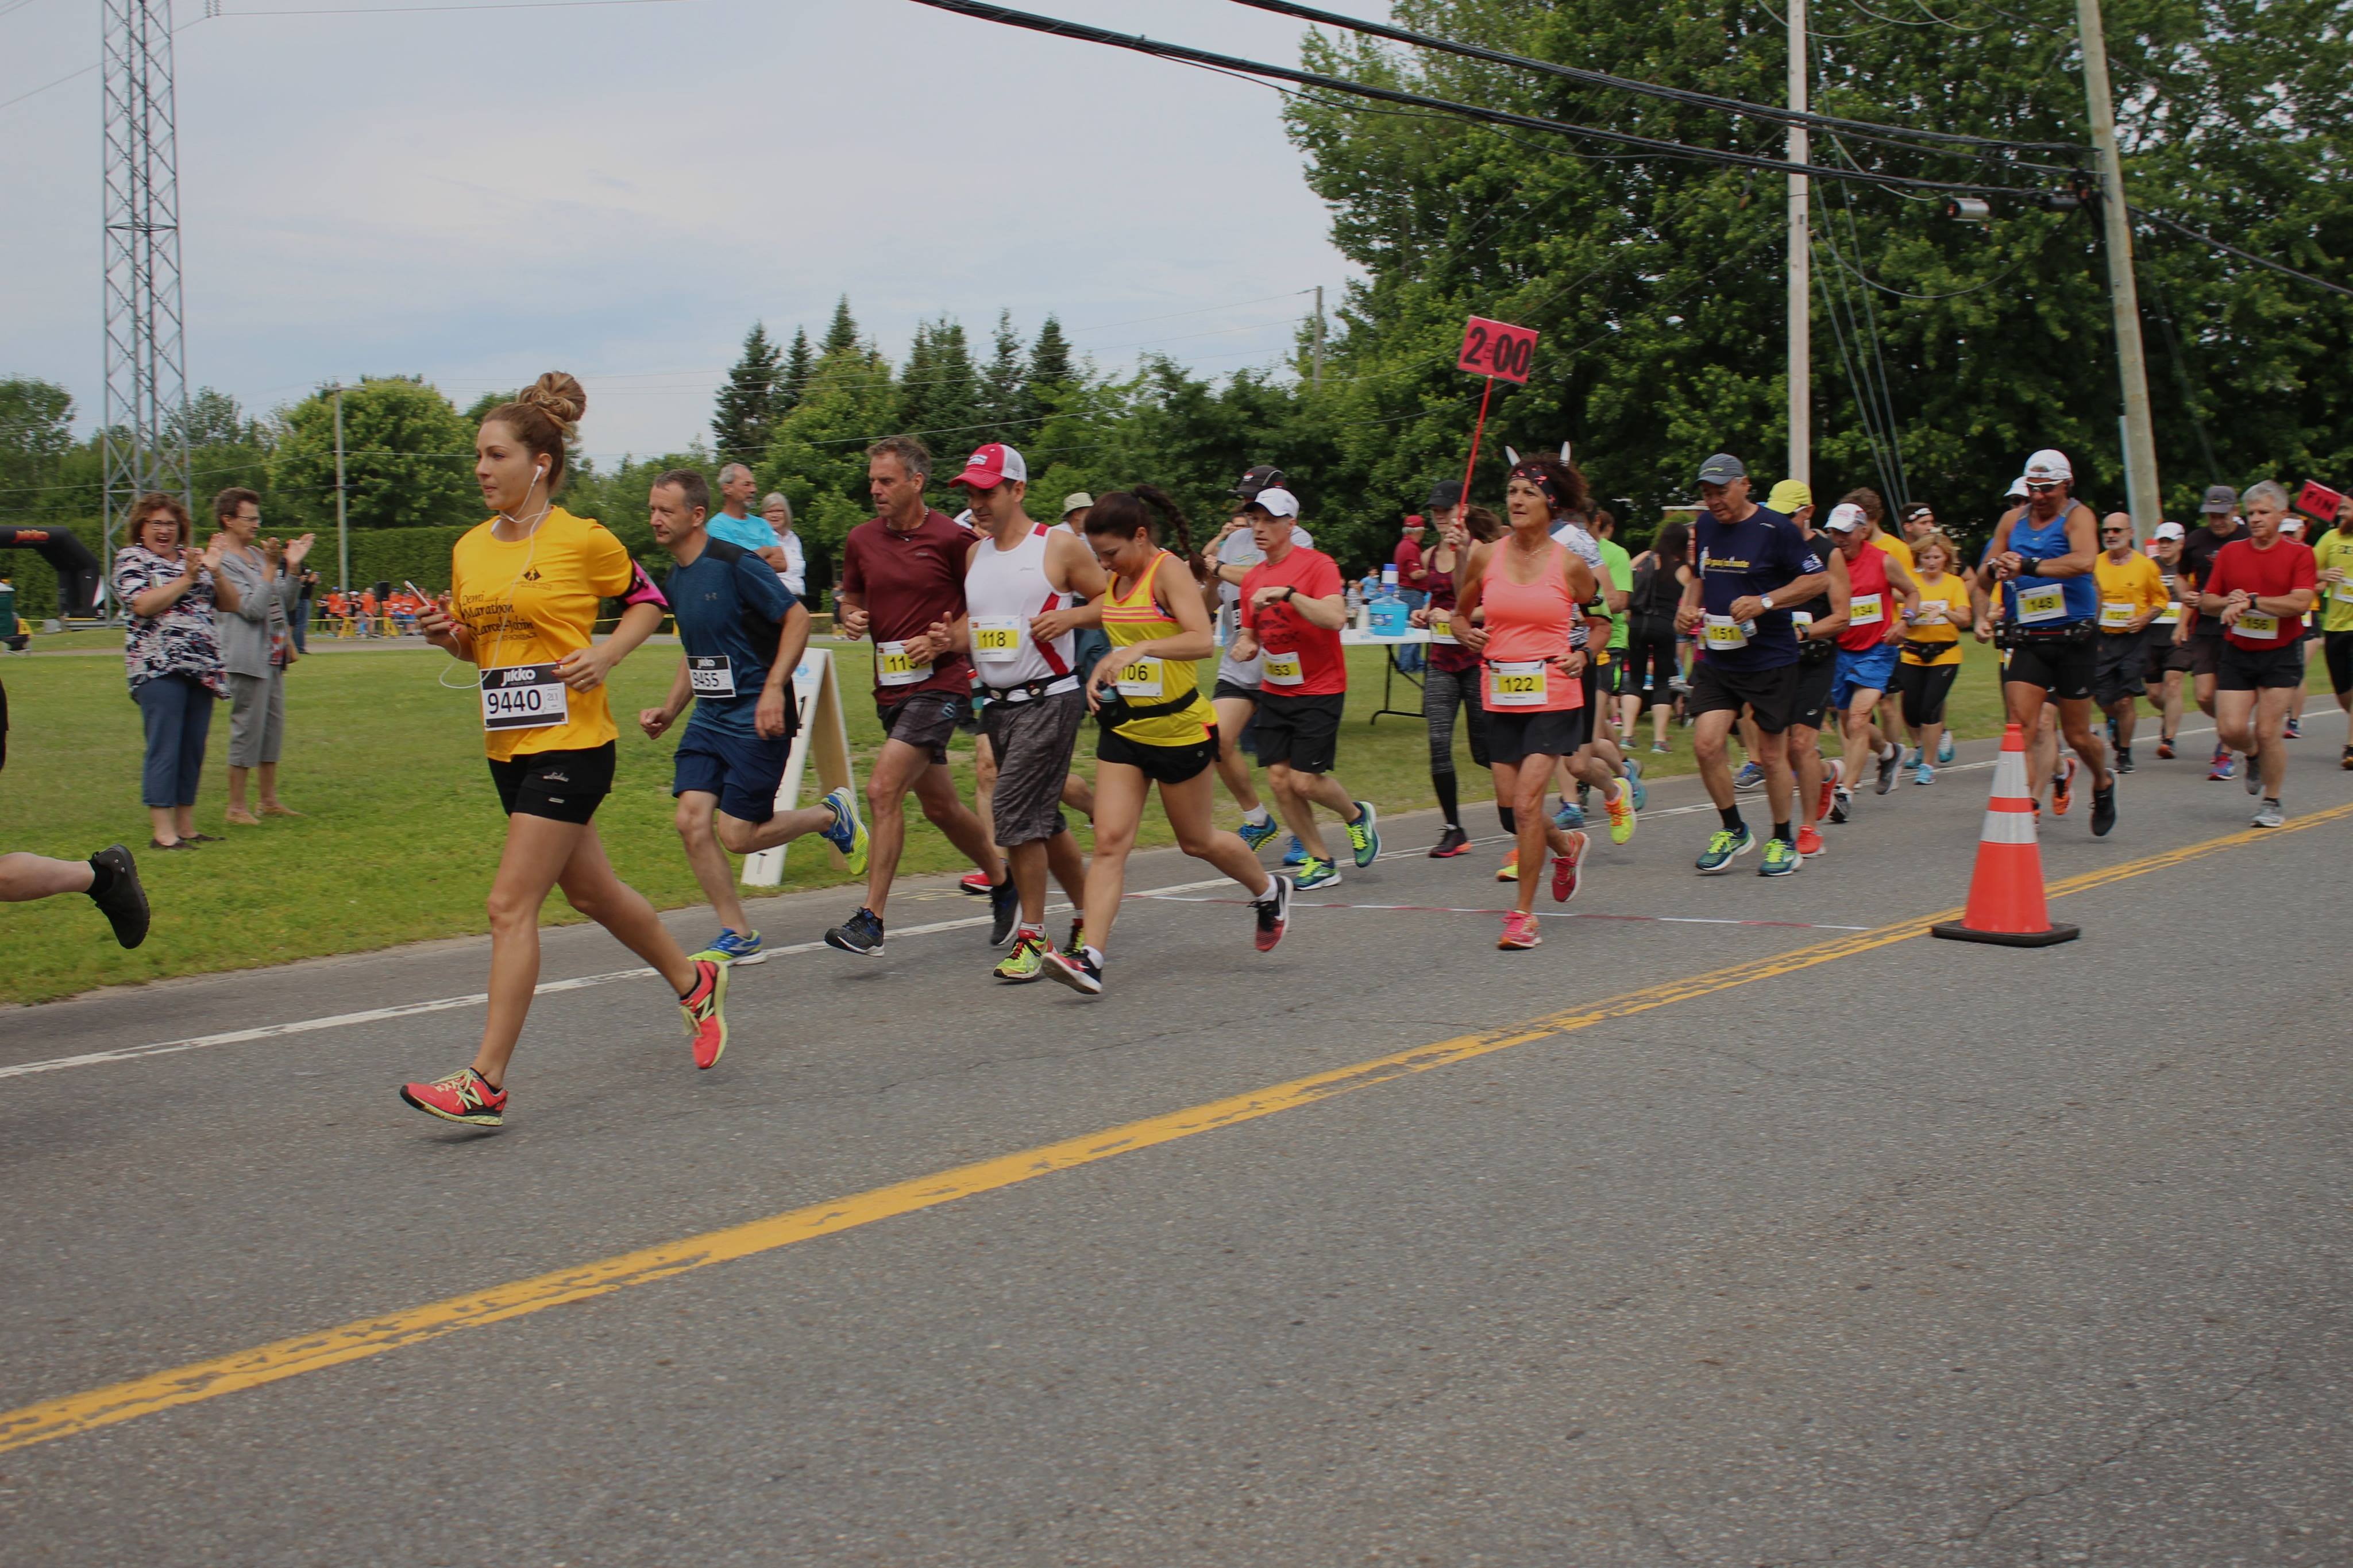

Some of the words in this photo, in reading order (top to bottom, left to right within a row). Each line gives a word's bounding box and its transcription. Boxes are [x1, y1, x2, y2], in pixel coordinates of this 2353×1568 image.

[460, 597, 514, 620] Marathon
[1852, 604, 1873, 617] 134
[982, 631, 1005, 647] 118
[1712, 628, 1734, 640] 151
[1268, 664, 1290, 676] 153
[692, 671, 719, 687] 9455
[1505, 677, 1533, 692] 122
[488, 689, 541, 715] 9440
